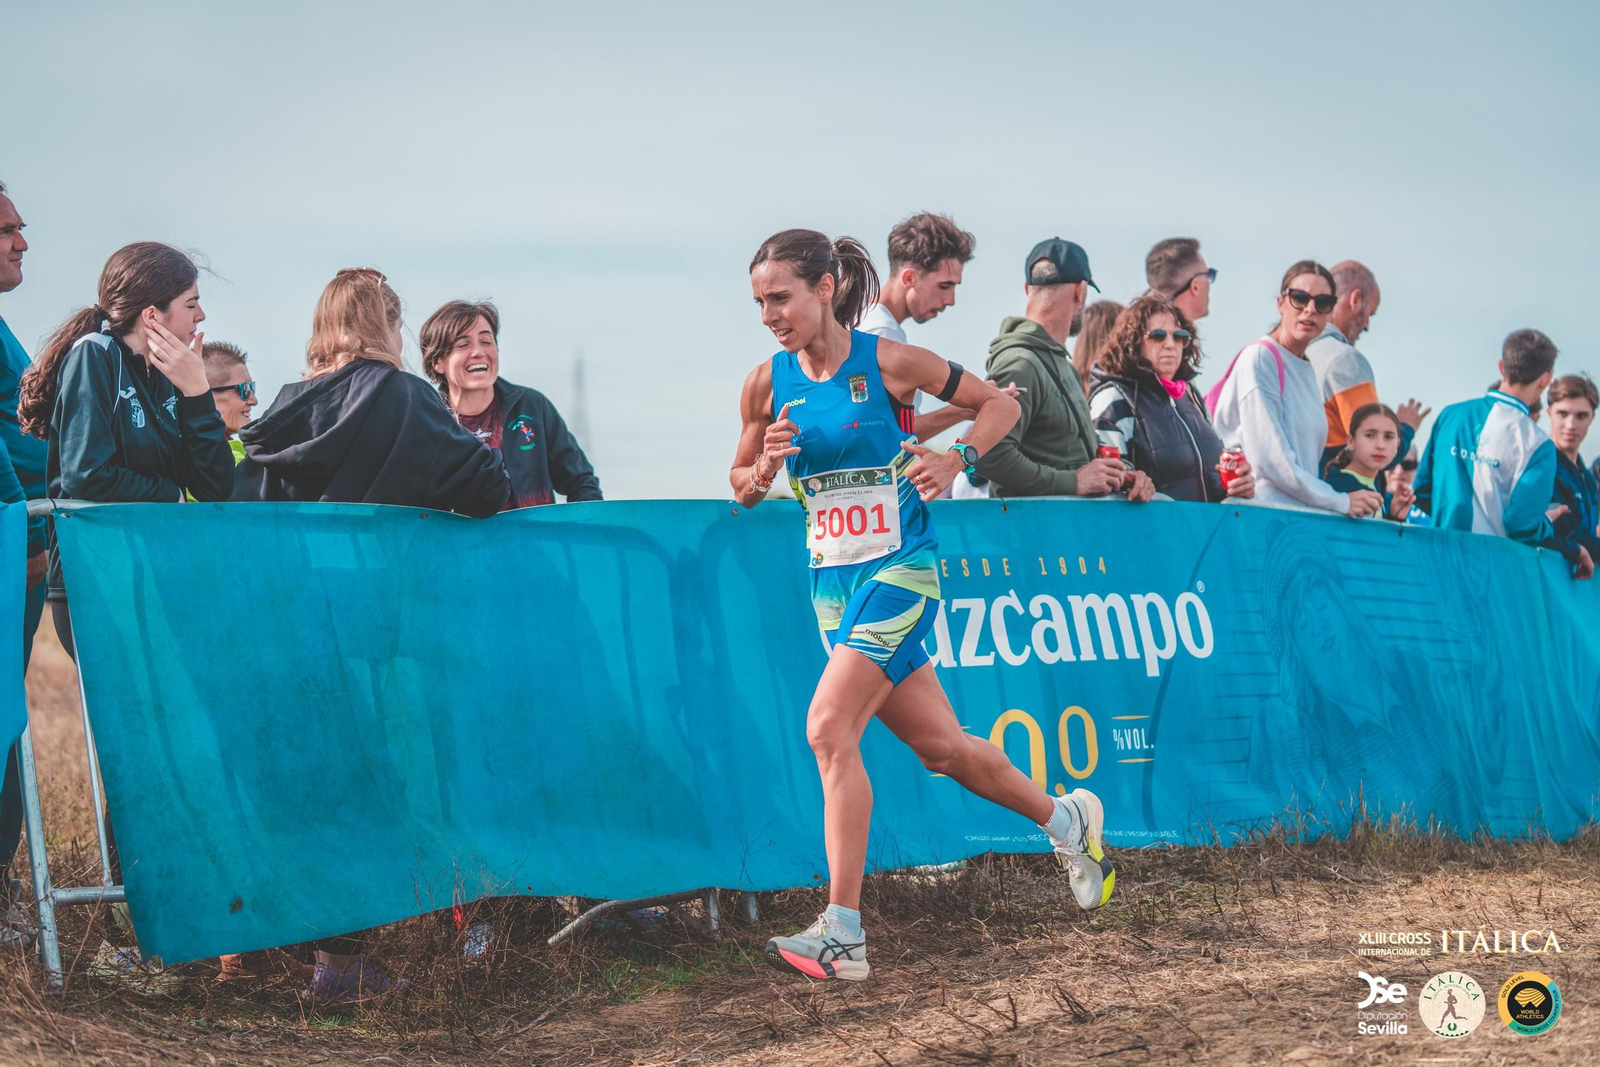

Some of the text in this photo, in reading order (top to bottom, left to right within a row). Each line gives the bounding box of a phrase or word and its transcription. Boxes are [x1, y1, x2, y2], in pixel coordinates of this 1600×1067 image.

[785, 397, 806, 407] mobel
[826, 474, 867, 488] ITÁLICA
[815, 503, 891, 540] 5001
[941, 556, 1107, 578] ESDE 1904
[820, 589, 1214, 677] uzcampo
[864, 628, 890, 647] mobel
[1113, 728, 1154, 750] %VOL.
